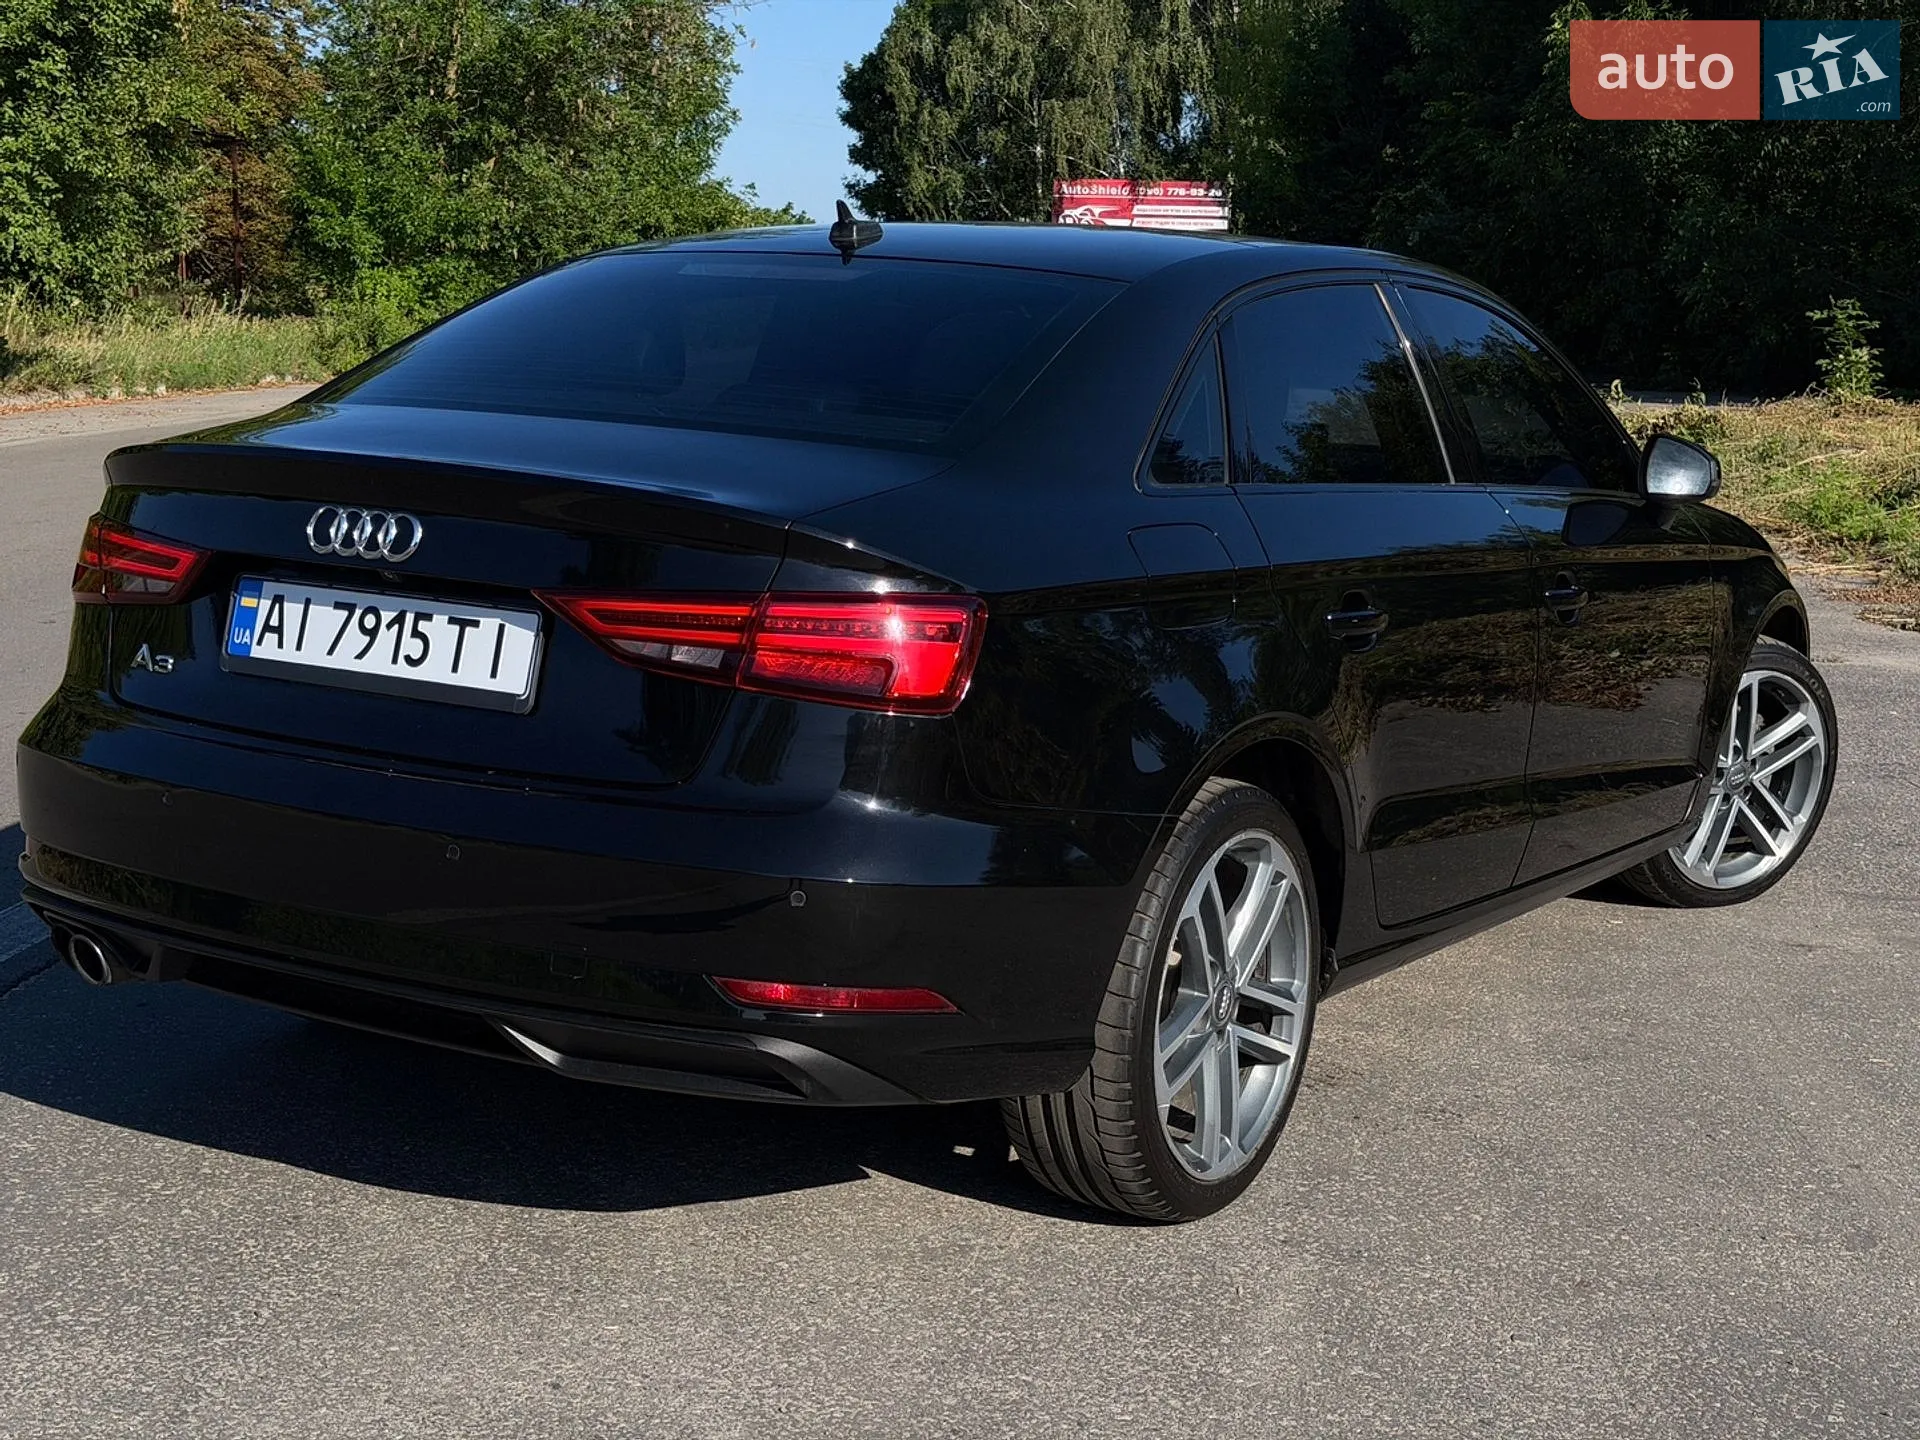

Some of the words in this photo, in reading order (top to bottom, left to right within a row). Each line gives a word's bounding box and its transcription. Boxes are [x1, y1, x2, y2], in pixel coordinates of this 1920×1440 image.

[1060, 183, 1131, 195] AutoShield
[233, 627, 251, 646] UA
[256, 594, 312, 652] AI
[326, 601, 435, 668] 7915
[447, 616, 506, 679] TI
[130, 643, 175, 673] A3
